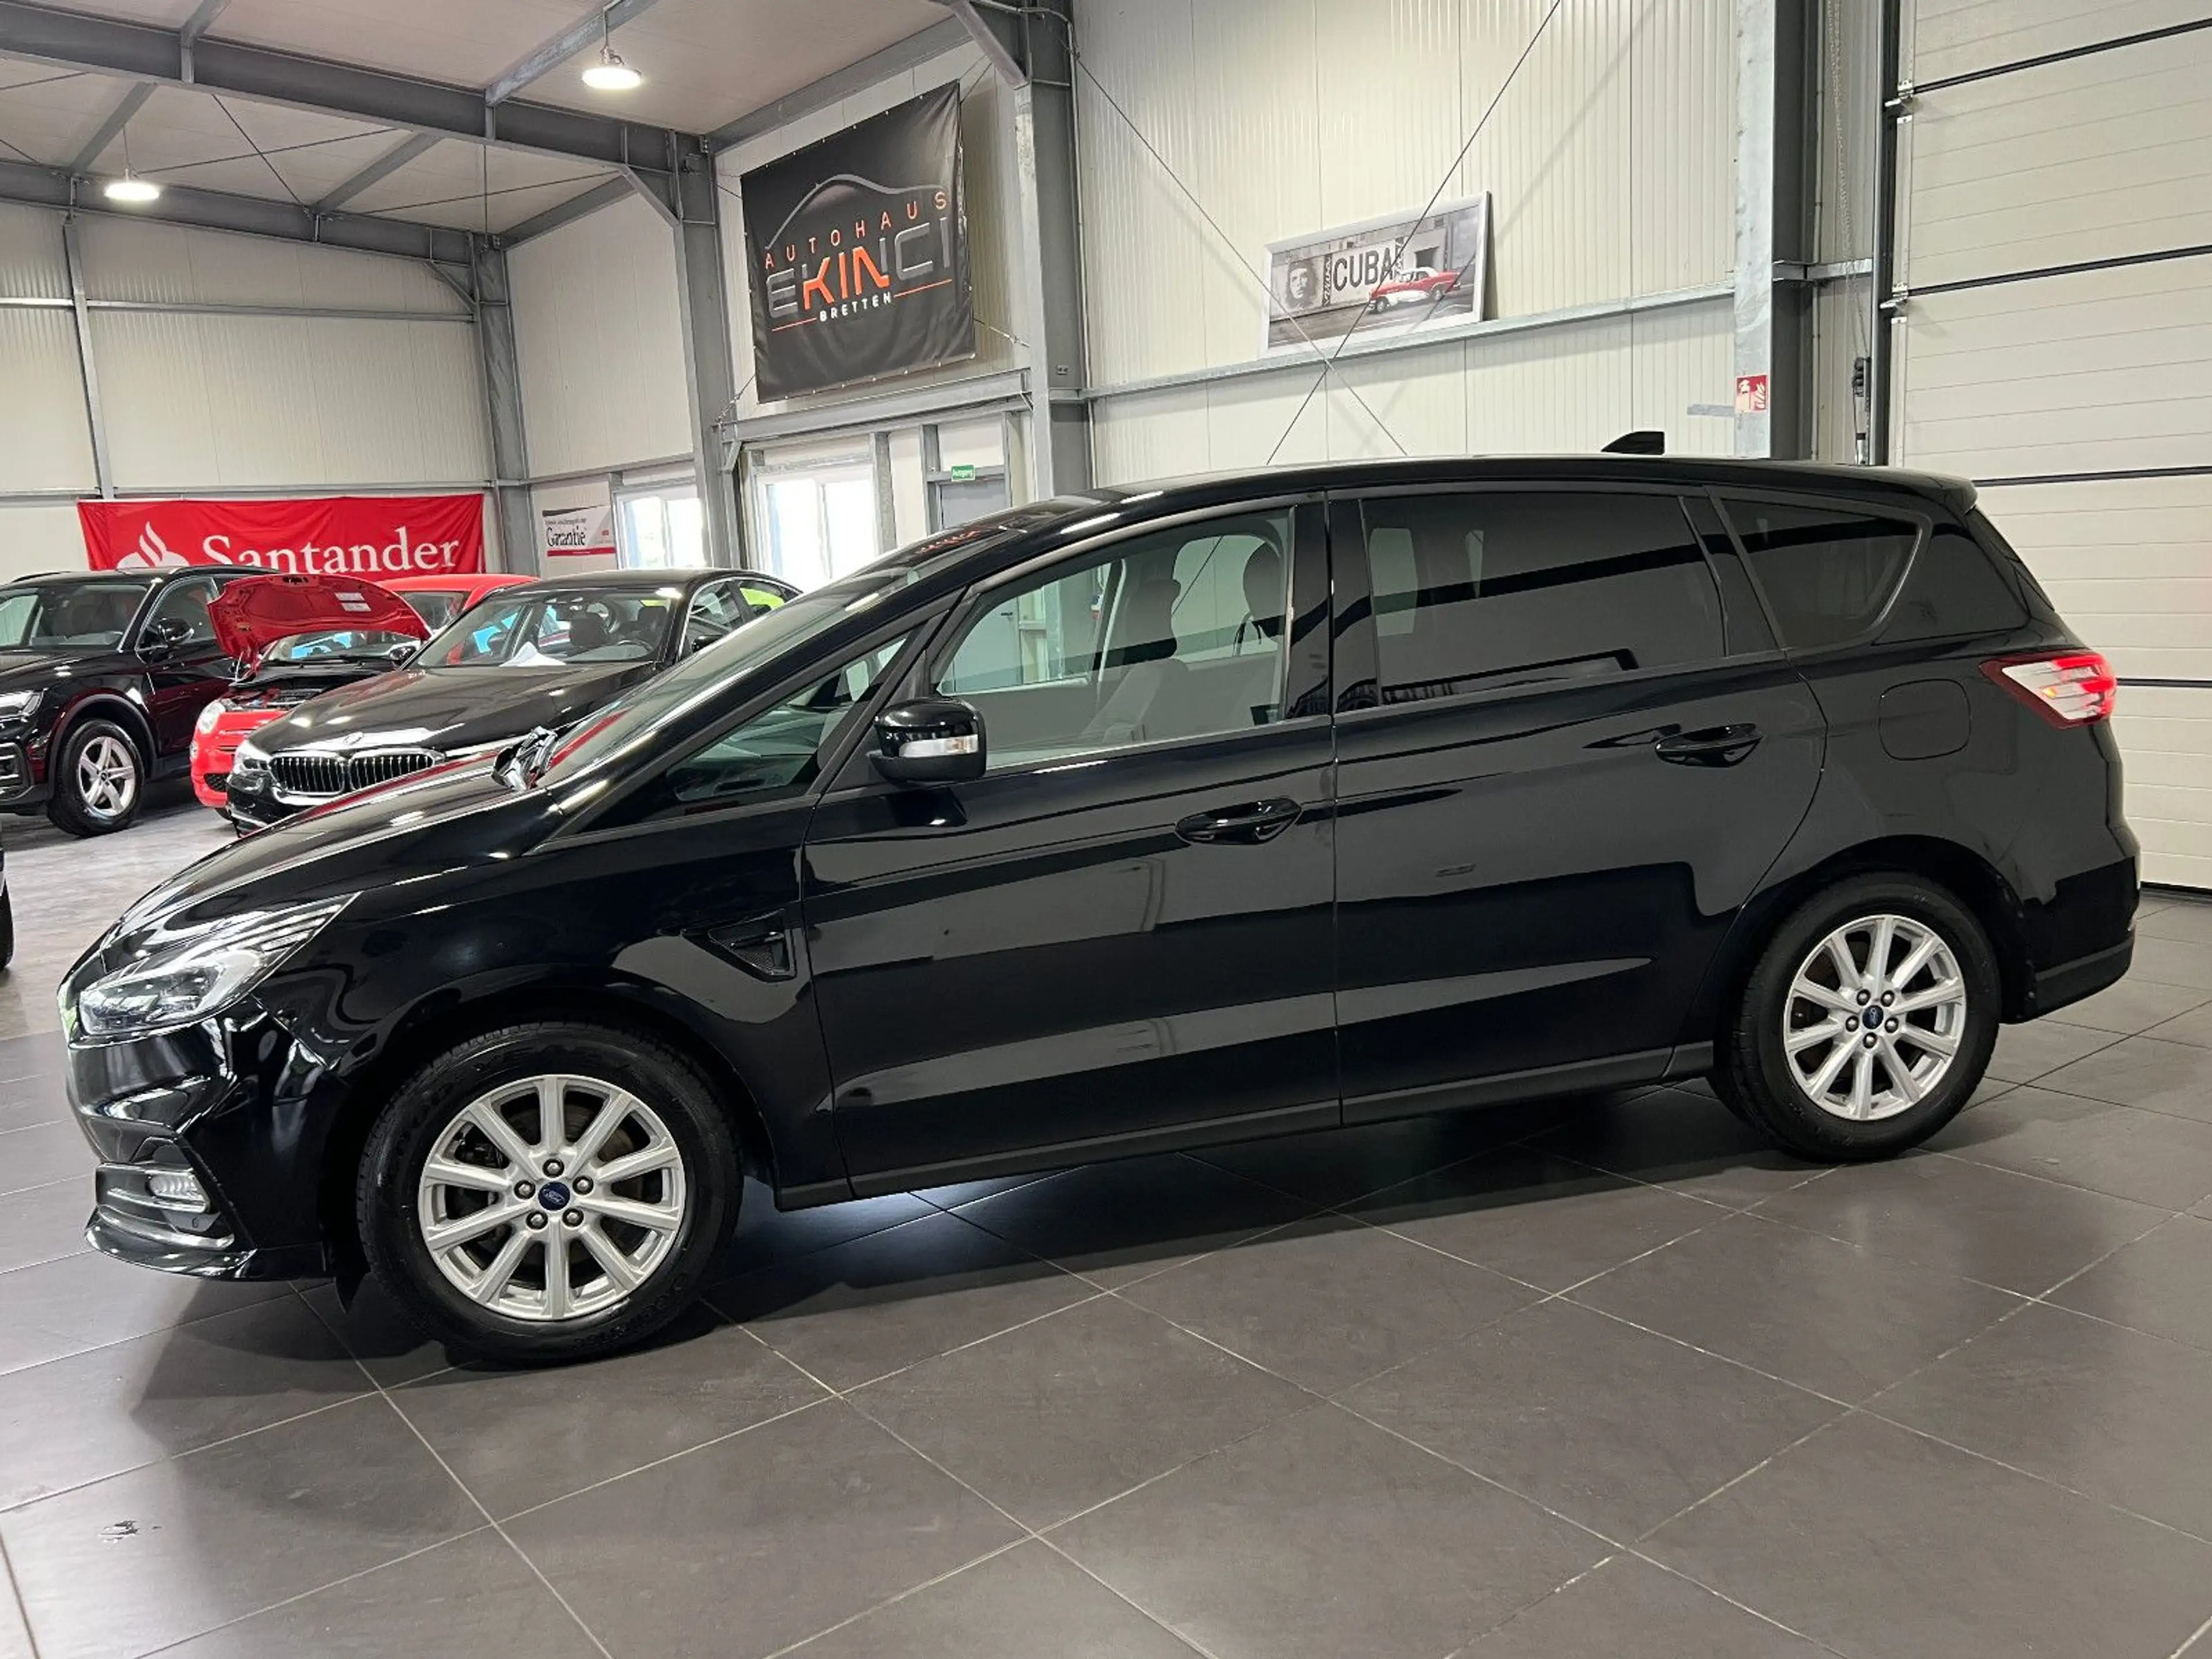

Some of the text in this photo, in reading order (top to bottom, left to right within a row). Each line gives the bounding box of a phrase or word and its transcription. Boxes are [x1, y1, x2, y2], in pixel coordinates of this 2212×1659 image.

[764, 191, 947, 269] AUTOHAUS
[766, 217, 950, 318] EKINCI
[1334, 248, 1393, 291] CUBA
[819, 291, 892, 322] BRETTEN
[202, 526, 459, 574] Santander
